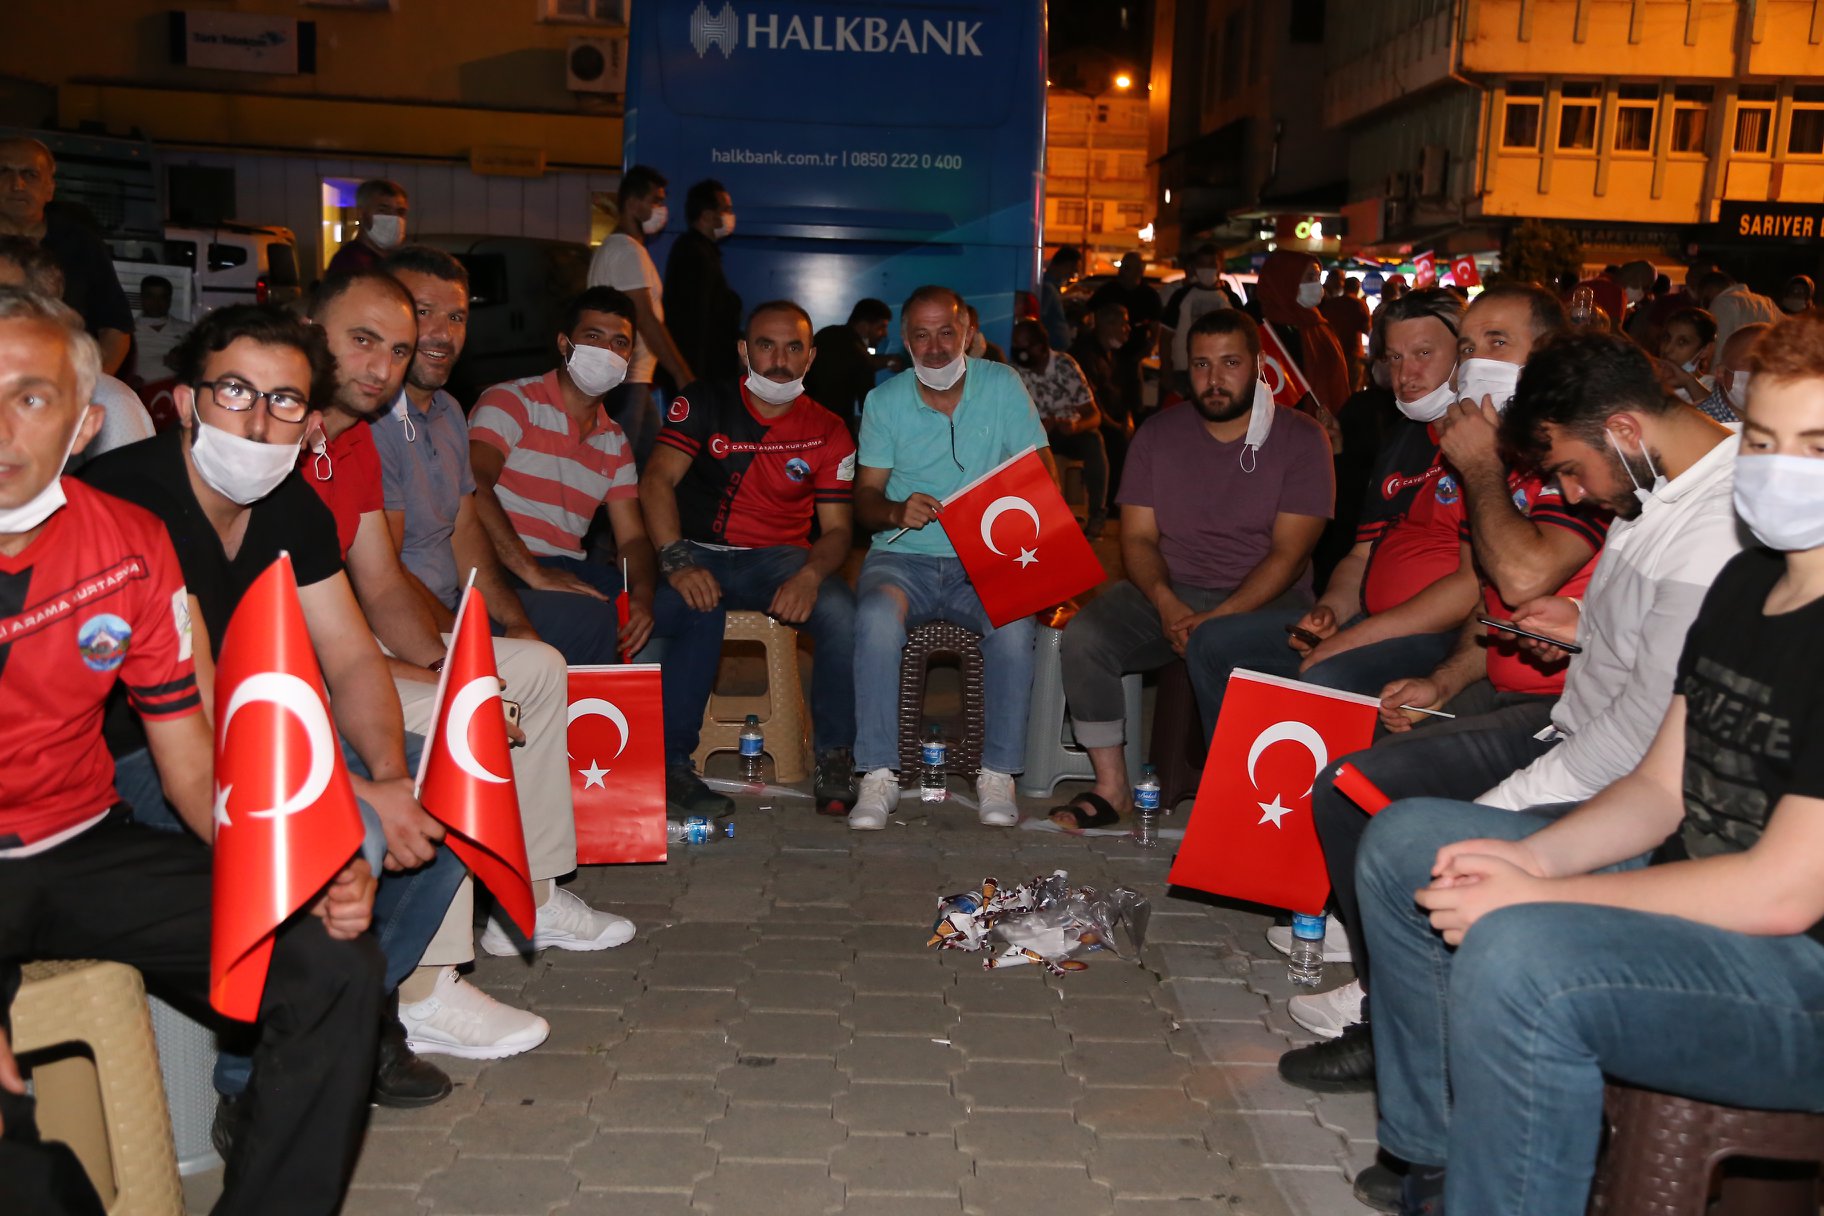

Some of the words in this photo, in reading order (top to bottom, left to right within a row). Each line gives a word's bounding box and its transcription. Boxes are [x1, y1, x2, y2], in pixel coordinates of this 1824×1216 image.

[746, 13, 983, 56] HALKBANK
[712, 148, 838, 167] halkbank.com.tr
[850, 152, 888, 168] 0850
[890, 153, 917, 169] 222
[921, 154, 932, 169] 0
[934, 154, 962, 171] 400
[1739, 213, 1814, 237] SARIYER
[12, 600, 70, 633] ARAMA
